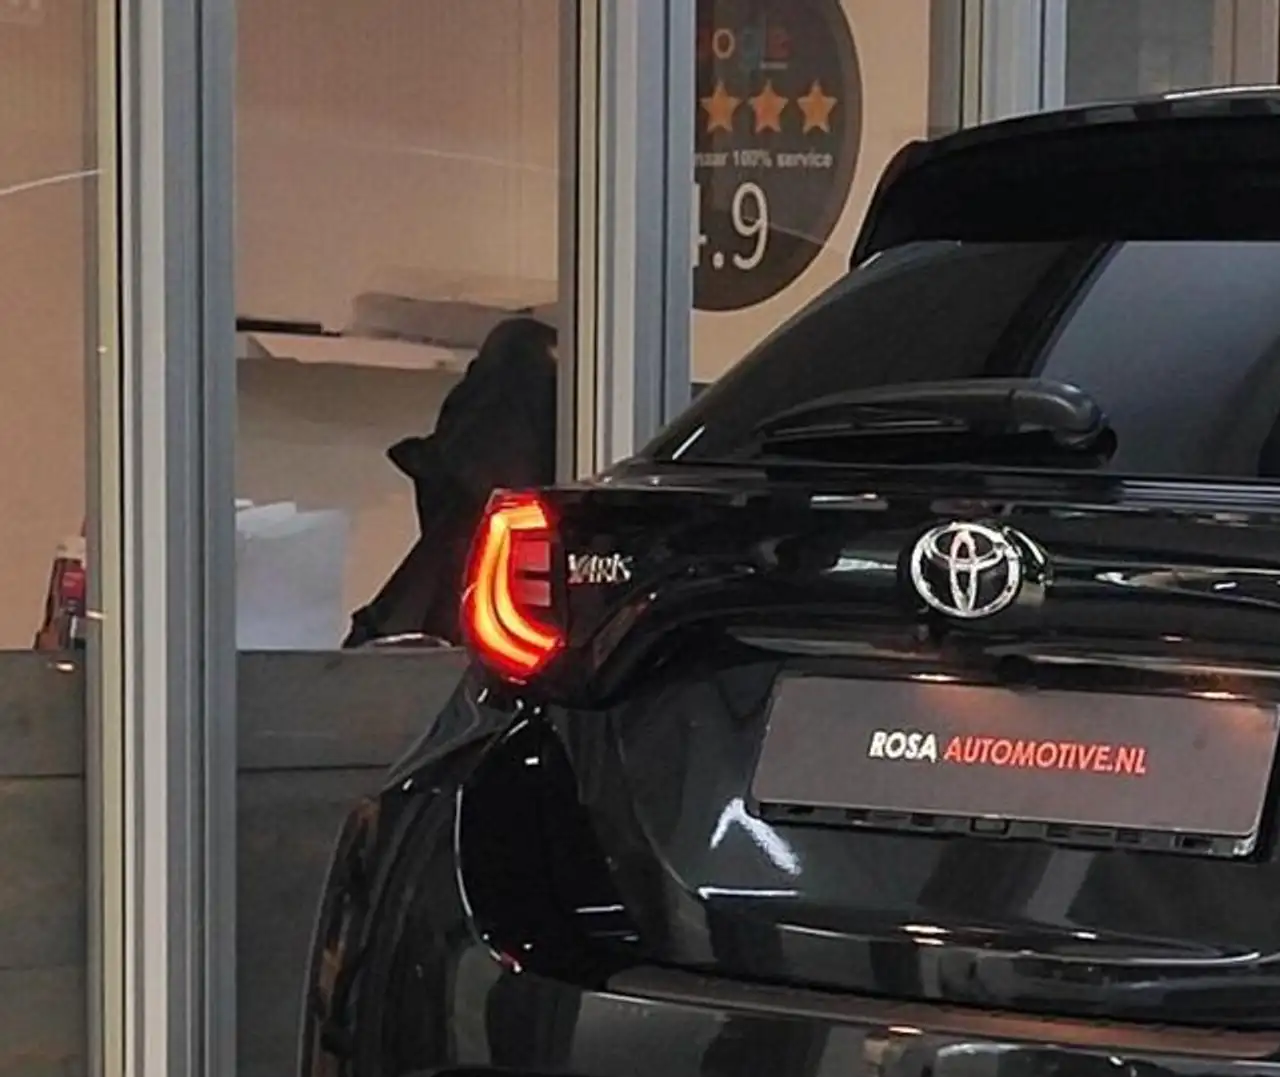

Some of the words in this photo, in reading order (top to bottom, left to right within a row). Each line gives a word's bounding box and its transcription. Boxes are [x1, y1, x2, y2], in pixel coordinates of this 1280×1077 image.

[776, 147, 833, 168] service
[868, 731, 937, 763] ROSA
[943, 735, 1148, 774] AUTOMOTIVE.NL
